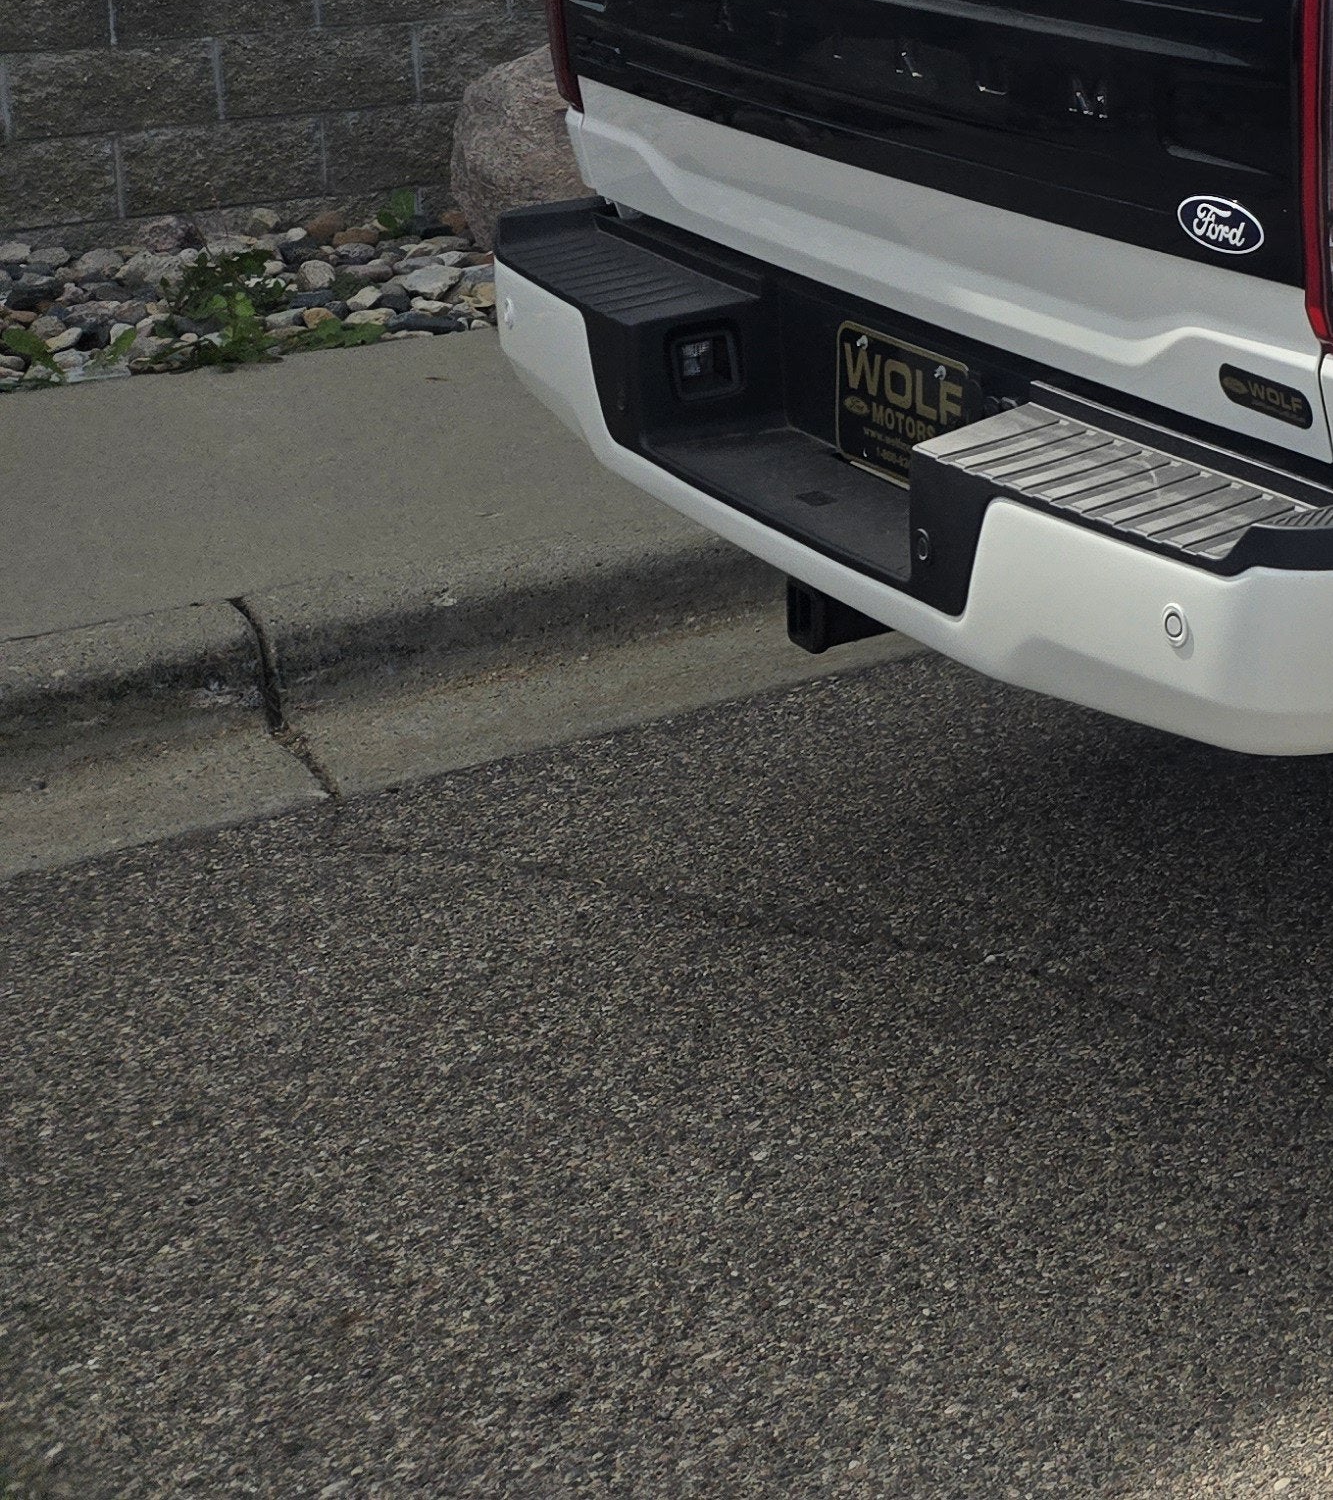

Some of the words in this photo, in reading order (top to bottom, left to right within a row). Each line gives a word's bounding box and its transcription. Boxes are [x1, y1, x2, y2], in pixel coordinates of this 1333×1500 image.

[1192, 203, 1246, 247] Ford
[843, 341, 964, 426] WOLF
[1247, 380, 1303, 412] WOLF
[871, 401, 937, 442] MOTORS
